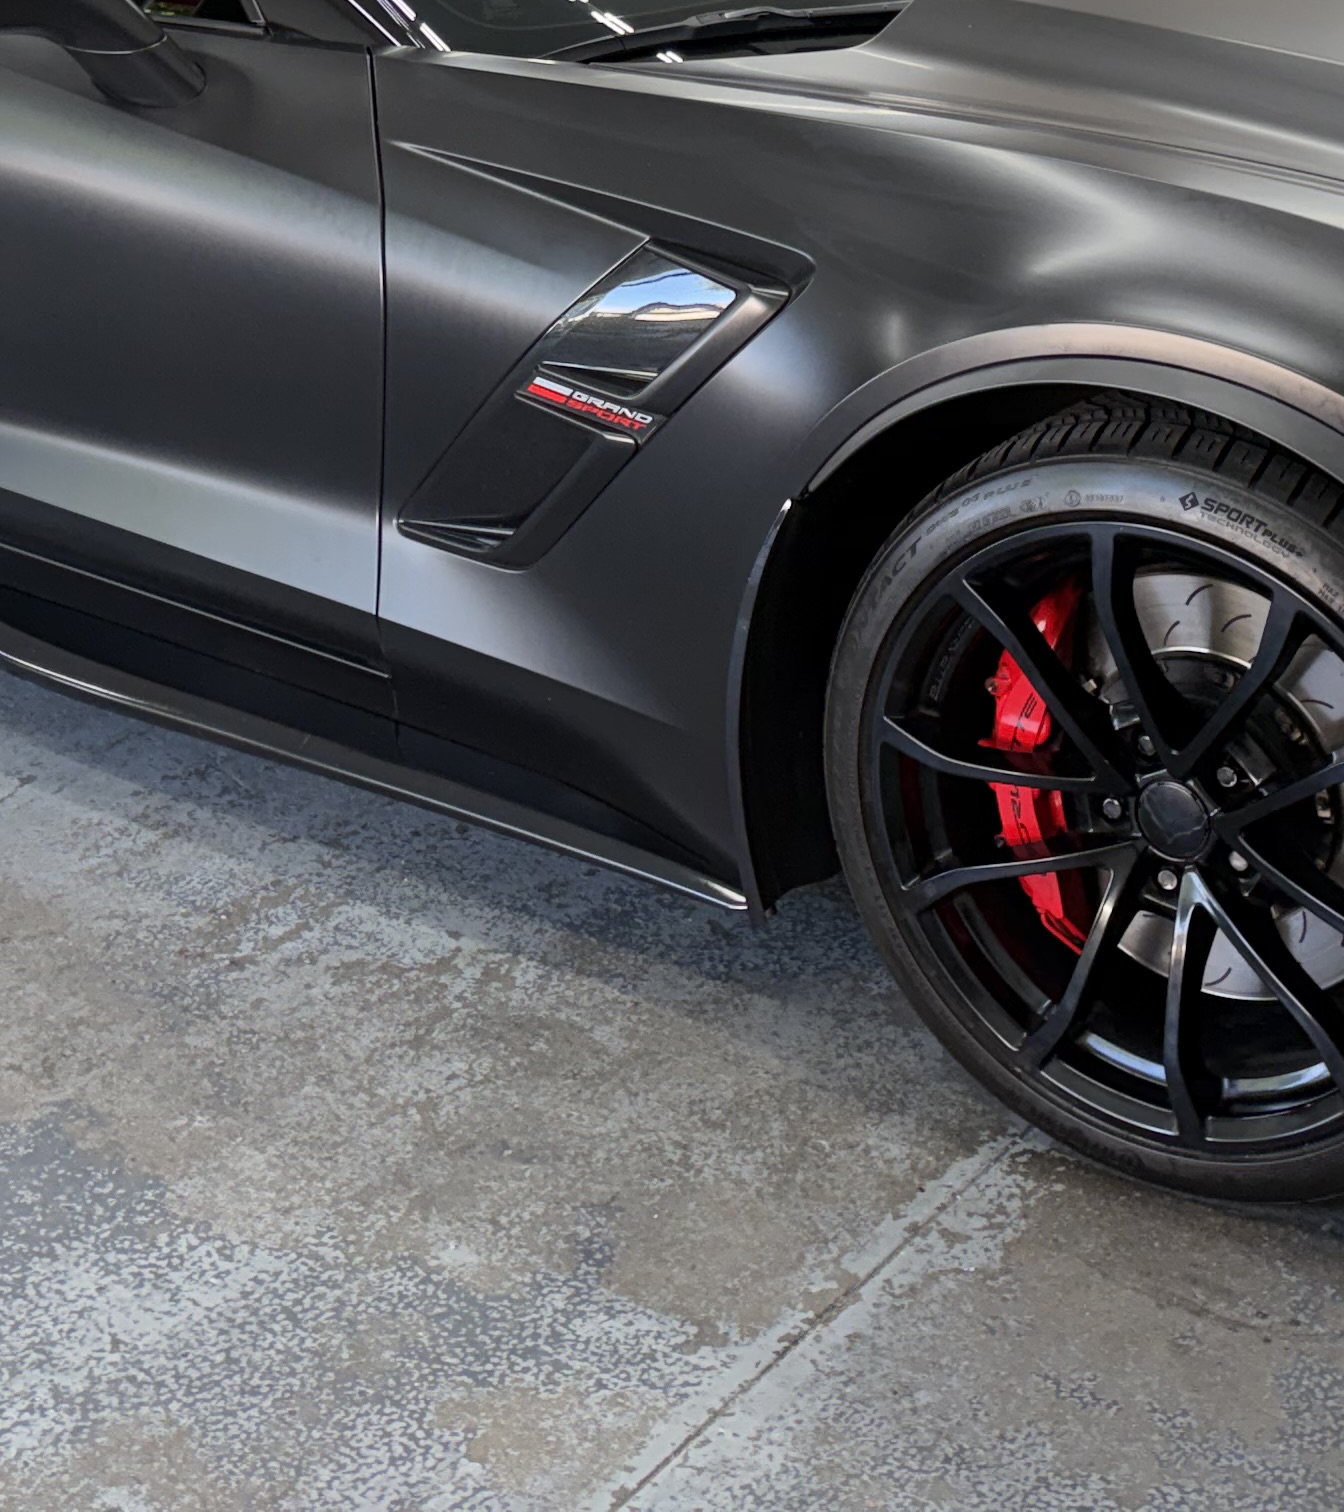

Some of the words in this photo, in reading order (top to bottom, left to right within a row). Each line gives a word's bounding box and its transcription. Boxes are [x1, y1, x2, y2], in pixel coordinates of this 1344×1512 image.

[566, 399, 647, 430] SPORT
[571, 391, 653, 424] GRAND
[1200, 497, 1268, 533] SPORT
[1199, 510, 1292, 559] TECHNOLOGY
